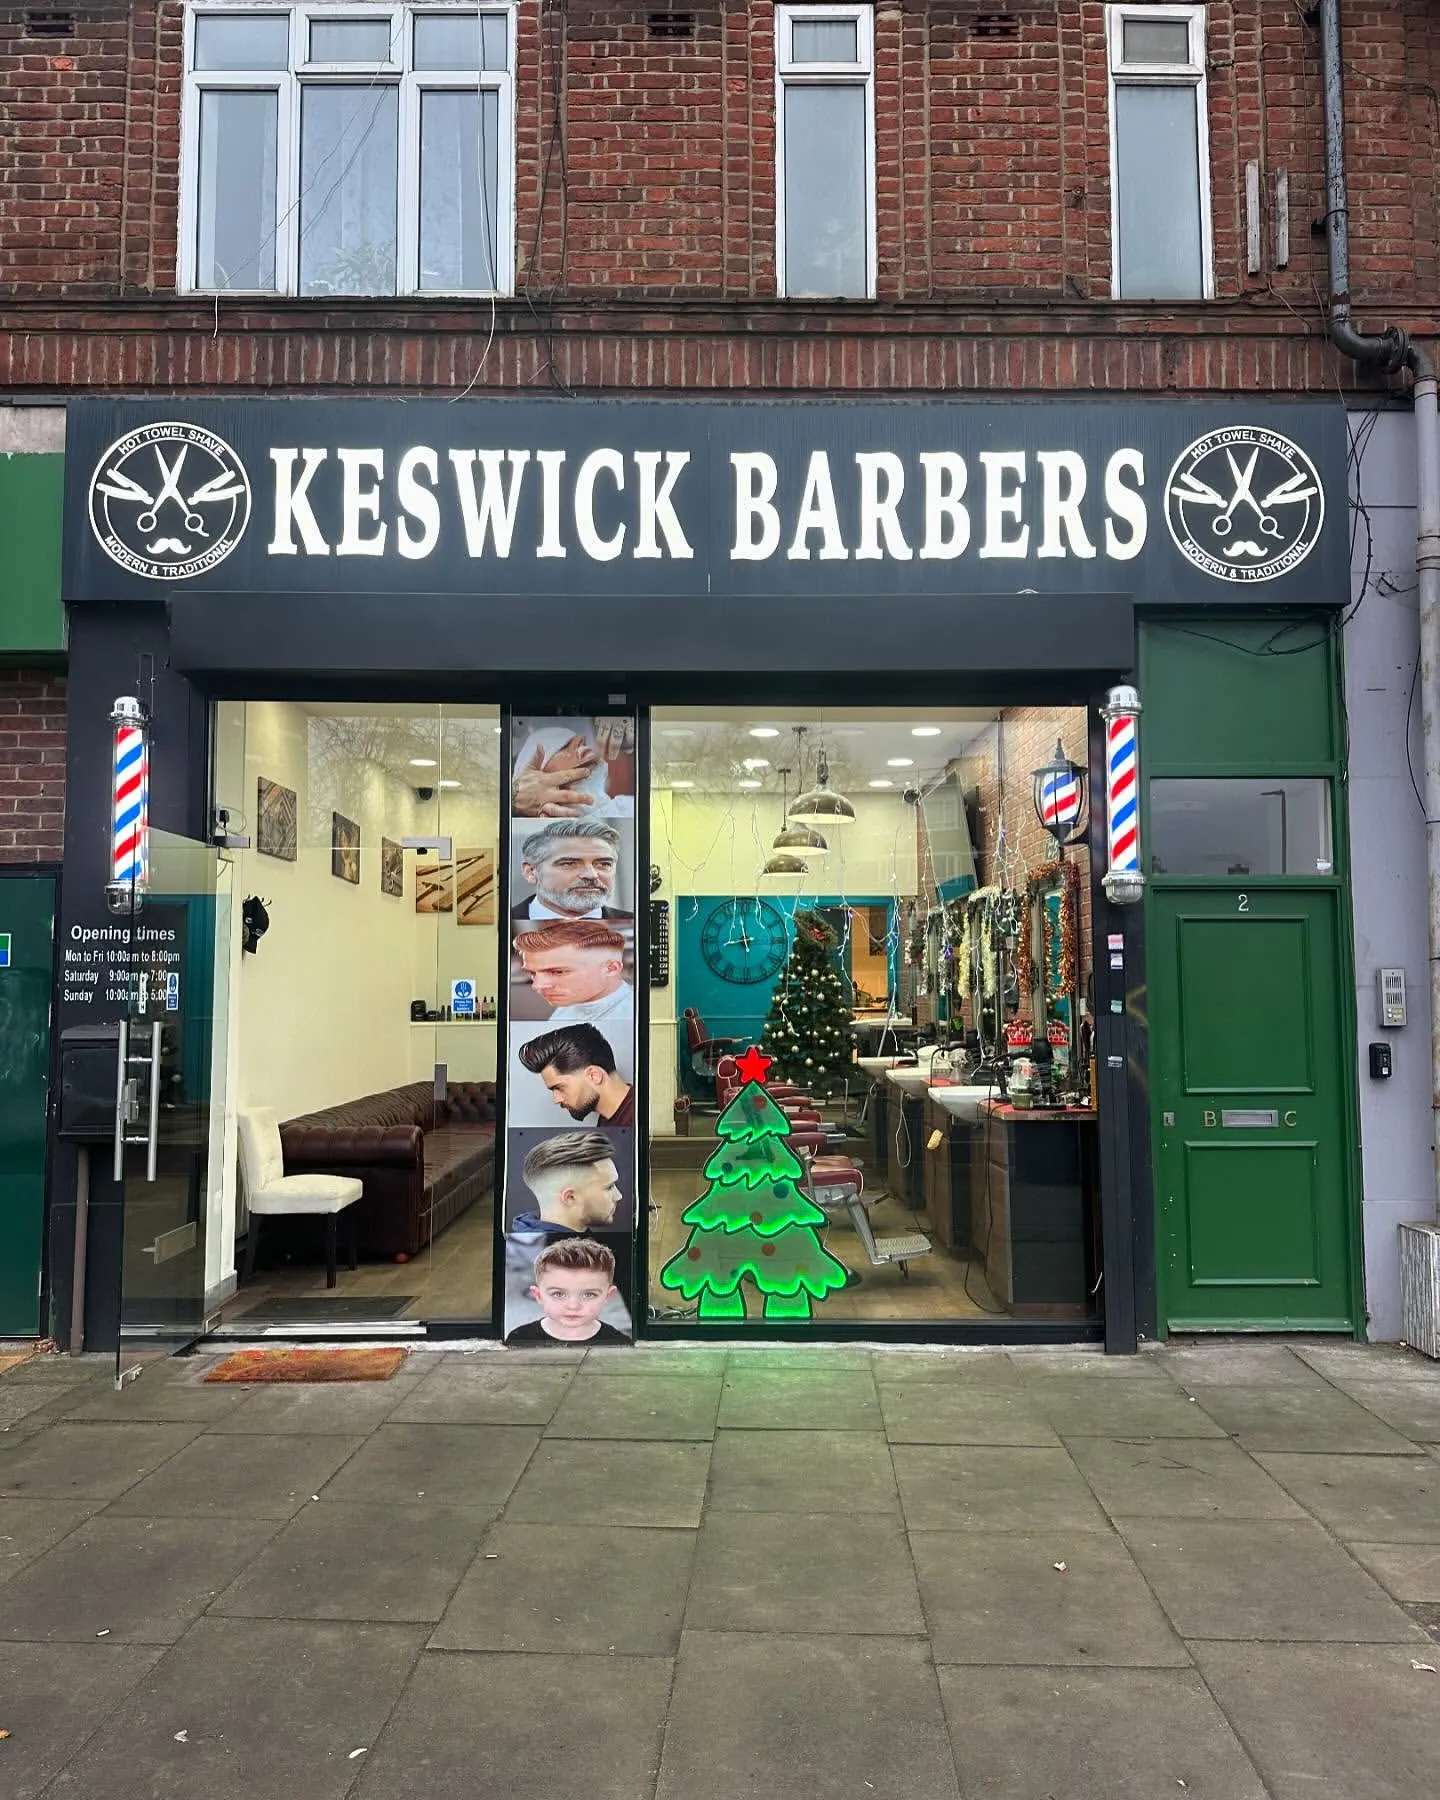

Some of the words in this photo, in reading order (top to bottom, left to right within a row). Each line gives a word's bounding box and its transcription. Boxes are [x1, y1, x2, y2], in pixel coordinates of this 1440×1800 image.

[117, 434, 143, 456] HOT
[143, 426, 186, 438] TOWEL
[187, 429, 226, 457] SHAVE
[1190, 438, 1216, 459] HOT
[1214, 430, 1257, 443] TOWEL
[1258, 433, 1296, 459] SHAVE
[267, 445, 695, 562] KESWICK
[729, 447, 1149, 562] BARBERS
[104, 535, 149, 573] MODERN
[150, 565, 159, 576] &
[162, 538, 234, 576] TRADITIONAL
[1181, 539, 1228, 576] MODERN
[1229, 568, 1238, 578] &
[1241, 541, 1309, 579] TRADITIONAL
[1238, 894, 1249, 912] 2
[71, 925, 131, 943] Opening
[137, 926, 176, 940] times
[65, 949, 82, 962] Mon
[83, 951, 92, 962] to
[93, 950, 104, 962] Fri
[106, 950, 139, 962] 10:00am
[141, 951, 150, 961] to
[151, 950, 180, 965] 8:00pm
[64, 969, 99, 985] Saturday
[109, 969, 139, 981] 9:00am
[63, 989, 94, 1004] Sunday
[105, 988, 139, 1001] 10:00am
[1203, 1110, 1217, 1127] B
[1284, 1110, 1297, 1127] C
